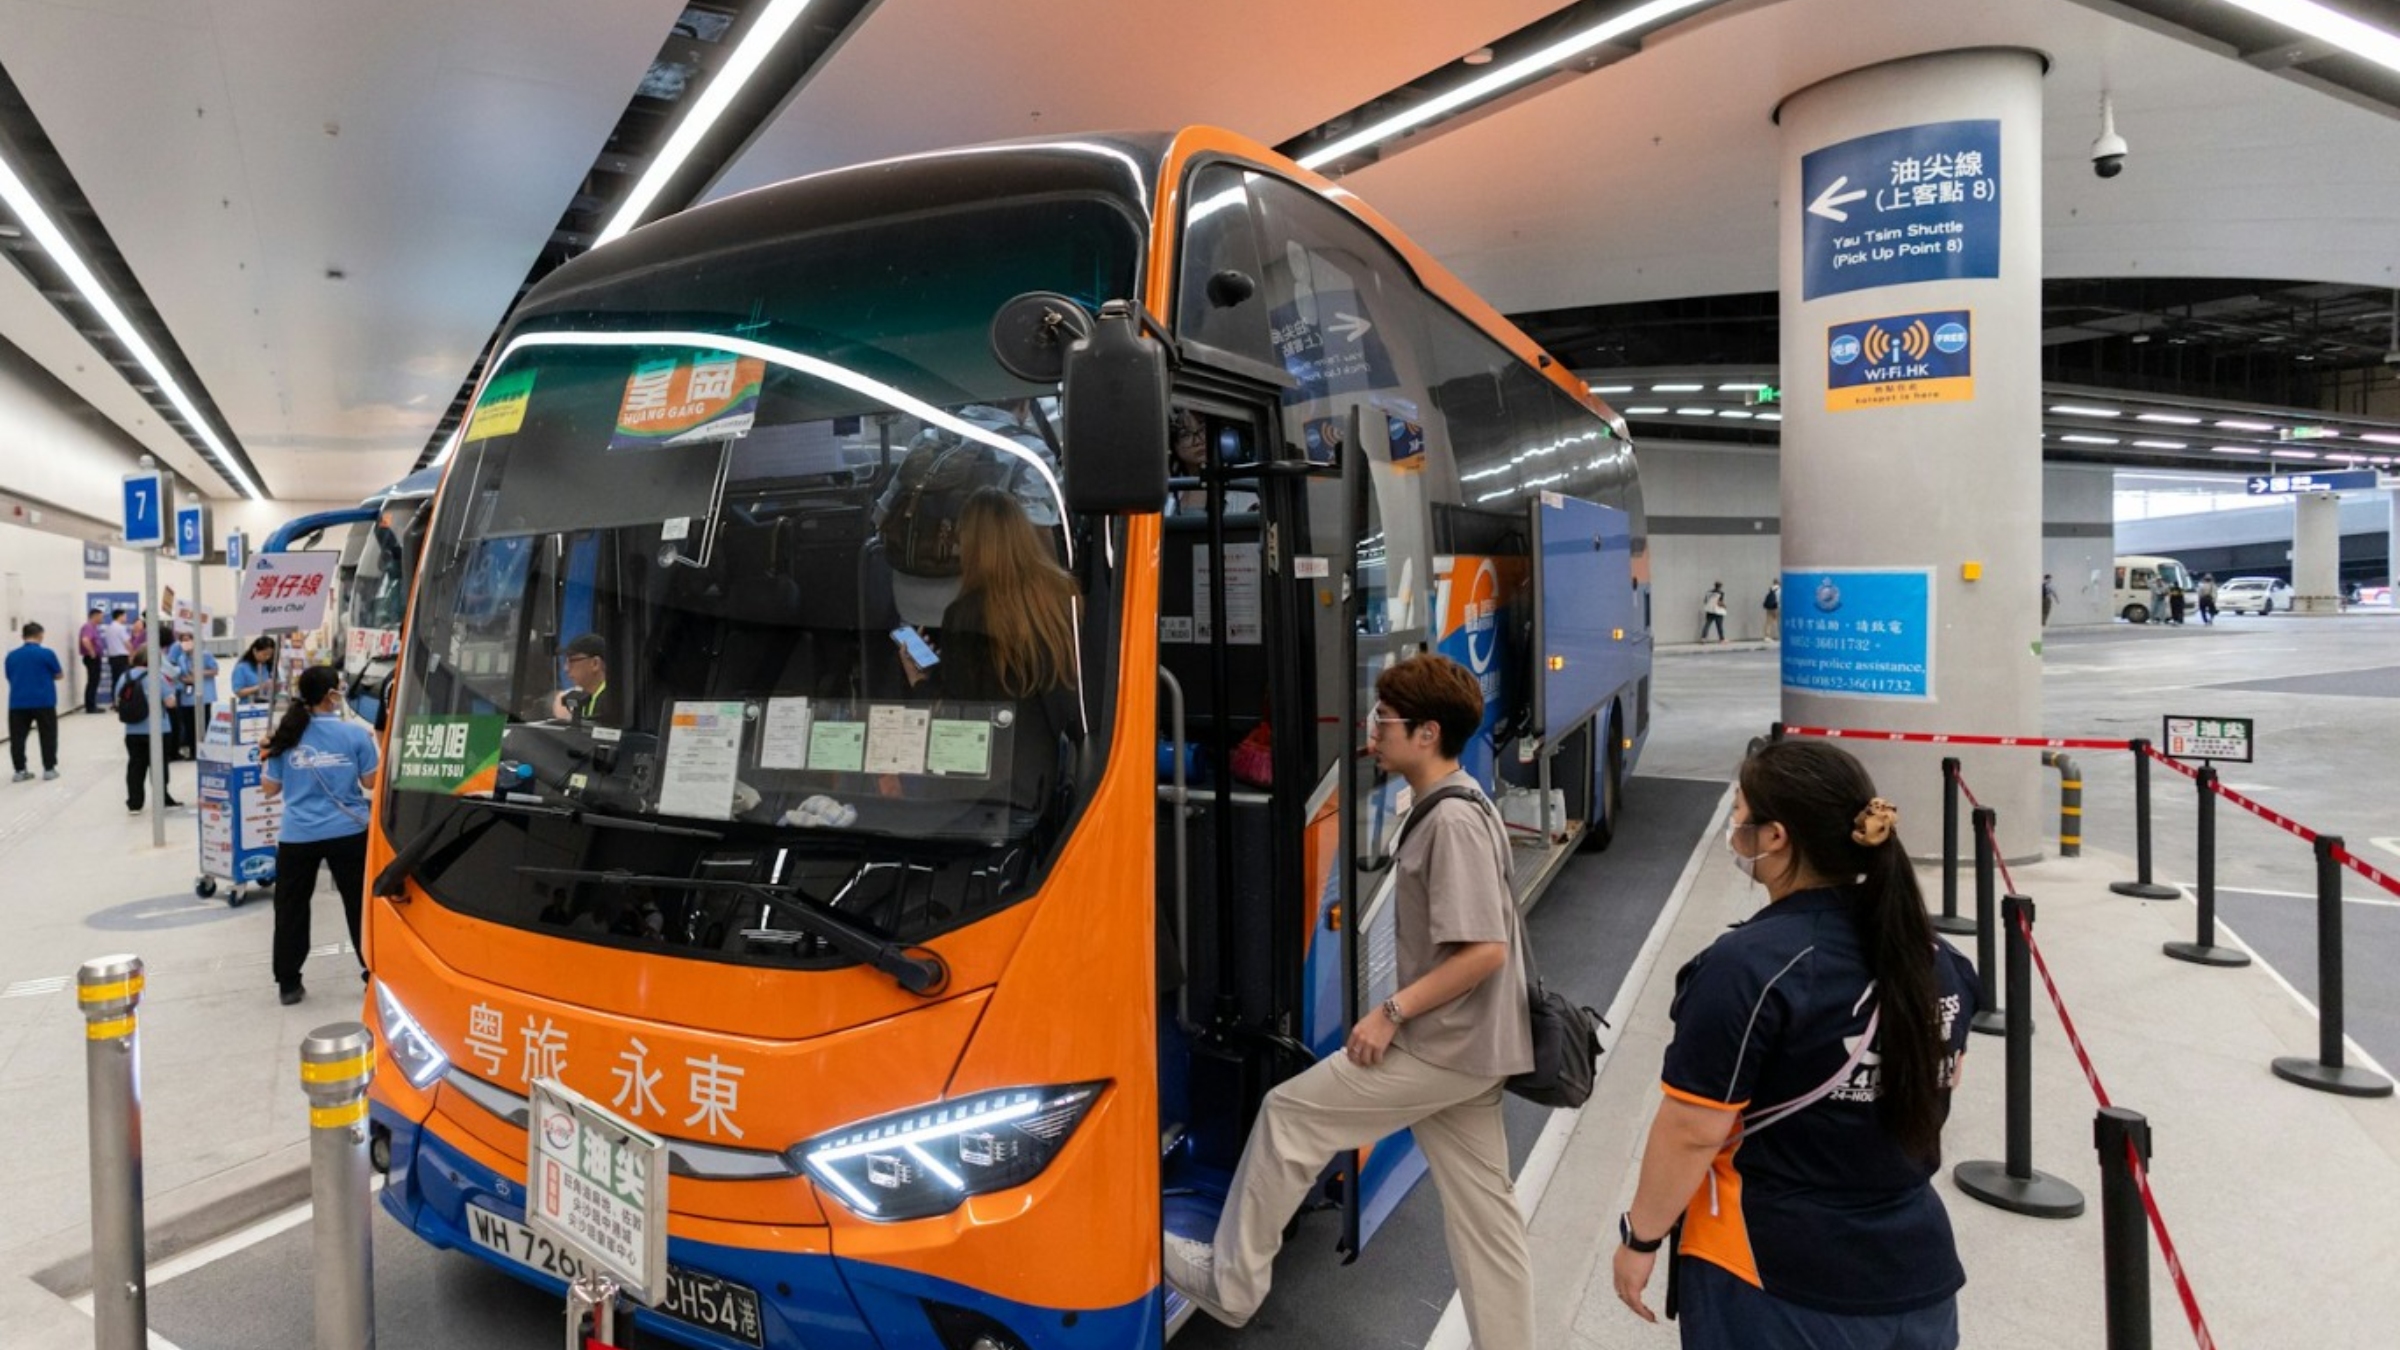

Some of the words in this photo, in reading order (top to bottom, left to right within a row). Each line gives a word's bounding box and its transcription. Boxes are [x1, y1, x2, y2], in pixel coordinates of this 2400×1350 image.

[1890, 150, 1983, 186] 油尖線
[1876, 181, 1964, 212] (上客點
[1973, 178, 1995, 202] 8)
[1832, 236, 1860, 250] Yau
[1865, 230, 1902, 243] Tsim
[1907, 219, 1964, 238] Shuttle
[1832, 252, 1868, 269] (Pick
[1872, 248, 1894, 261] Up
[1899, 241, 1941, 257] Point
[1946, 237, 1964, 254] 8)
[1937, 332, 1966, 344] FREE
[1864, 363, 1929, 381] Wi-Fi.HK
[624, 406, 665, 425] HUANG
[135, 491, 147, 520] 7
[184, 519, 193, 540] 6
[251, 572, 323, 600] 灣仔線
[261, 603, 283, 614] Wan
[285, 602, 306, 612] Chai
[1819, 658, 1851, 671] police
[1855, 661, 1926, 674] assistance,
[404, 723, 469, 758] 尖沙咀
[401, 763, 422, 777] TSIM
[422, 763, 440, 777] SHA
[441, 764, 465, 777] TSUI
[611, 1036, 746, 1140] 永東
[582, 1126, 645, 1204] 油尖
[474, 1211, 509, 1254] WH
